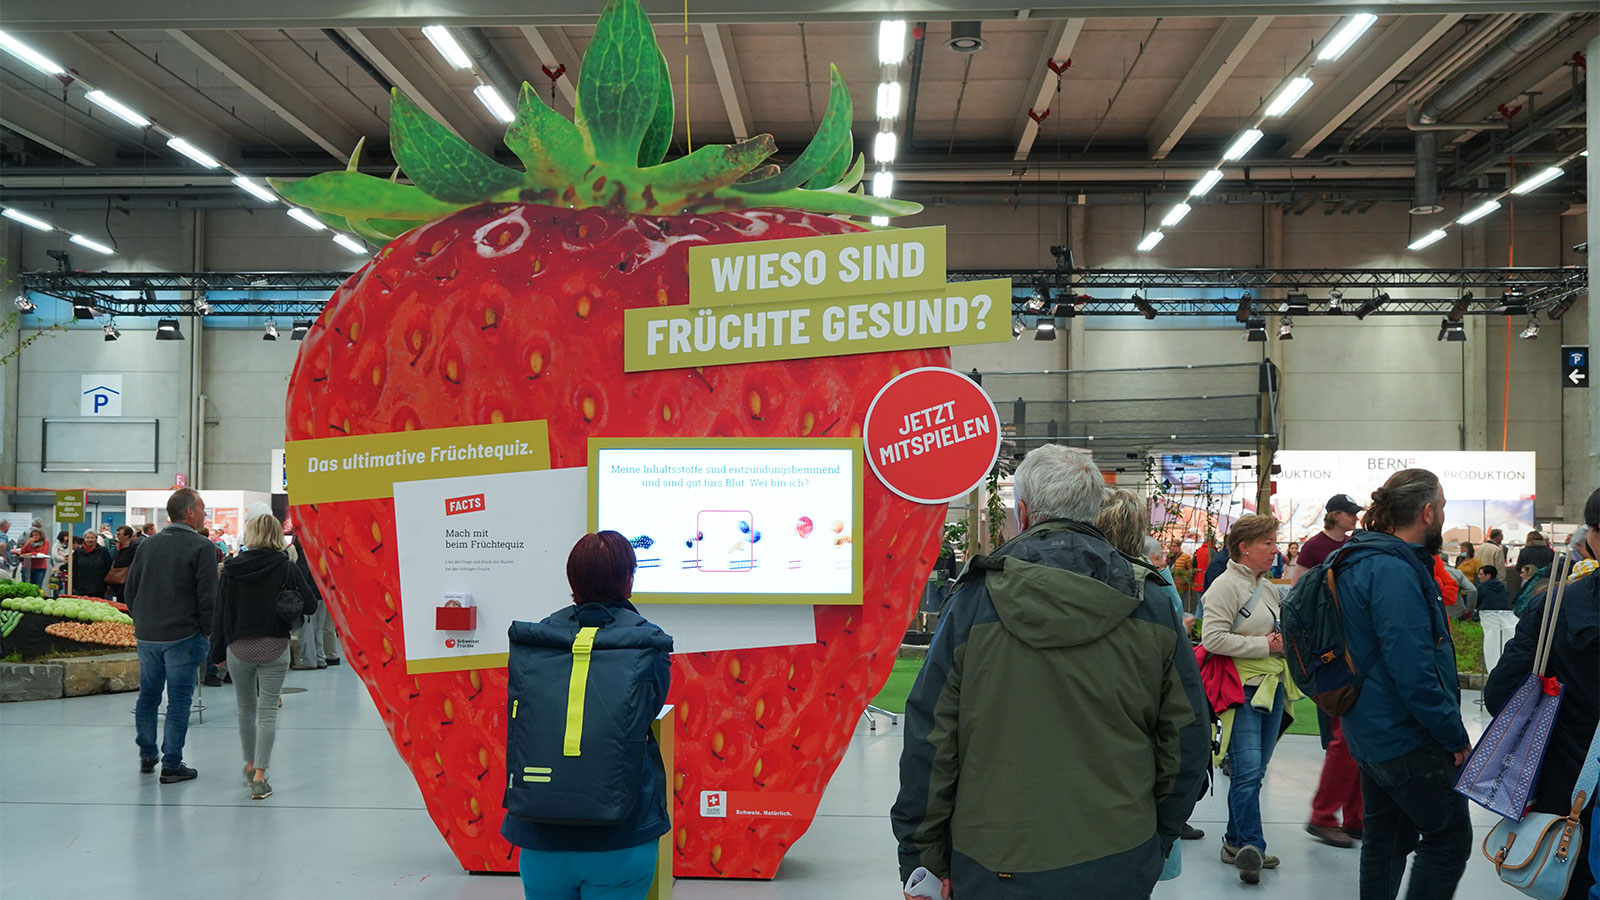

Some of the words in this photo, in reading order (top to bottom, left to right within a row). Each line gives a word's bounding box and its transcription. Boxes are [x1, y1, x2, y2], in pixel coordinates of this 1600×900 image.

[711, 249, 826, 293] WIESO
[838, 242, 925, 282] SIND
[647, 308, 810, 356] FRÜCHTE
[822, 294, 992, 342] GESUND?
[898, 400, 956, 436] JETZT
[879, 414, 990, 466] MITSPIELEN
[307, 457, 338, 473] Das
[343, 449, 426, 471] ultimative
[430, 439, 534, 463] Früchtequiz.
[611, 464, 641, 474] Meine
[643, 464, 703, 474] Inhaltsstoffe
[705, 464, 727, 474] sind
[1367, 457, 1408, 471] BERN
[1444, 470, 1526, 480] PRODUKTION
[641, 478, 660, 487] und
[662, 478, 684, 487] sind
[685, 478, 702, 489] gut
[749, 478, 768, 487] Wer
[770, 478, 787, 487] bin
[789, 478, 809, 487] ich?
[449, 497, 481, 512] FACTS
[445, 529, 470, 538] Mach
[473, 529, 489, 538] mit
[445, 540, 468, 549] beim
[471, 540, 525, 550] Früchtequiz
